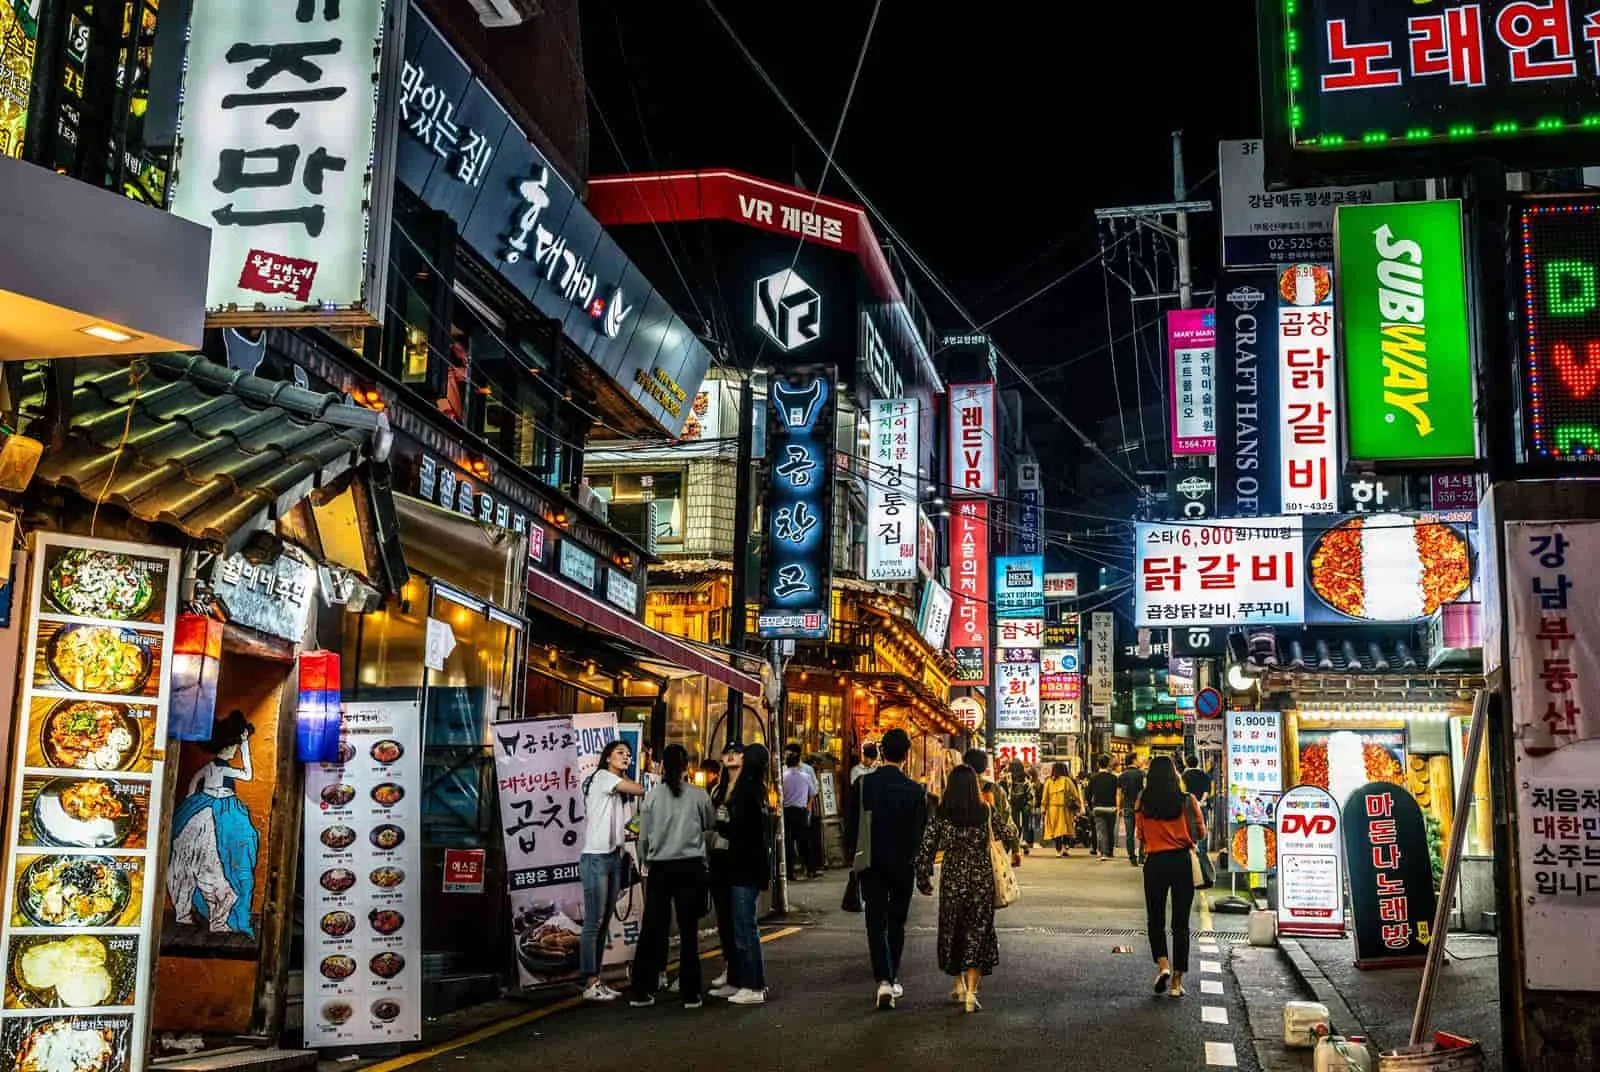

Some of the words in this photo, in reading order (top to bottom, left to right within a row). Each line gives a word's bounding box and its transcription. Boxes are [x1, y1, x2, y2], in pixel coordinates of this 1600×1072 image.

[212, 0, 346, 237] 주막
[400, 61, 460, 158] 맛있는
[458, 129, 492, 187] 집!
[1241, 142, 1258, 155] 3F
[739, 195, 772, 224] VR
[780, 205, 842, 243] 게임존
[1280, 312, 1331, 336] 곱창
[1373, 224, 1434, 437] SUBWAY
[1235, 314, 1258, 396] CRAFT
[1236, 402, 1259, 471] HANS
[1287, 348, 1331, 501] 닭갈비
[774, 445, 817, 597] 곱창고
[878, 464, 908, 546] 정통집
[1143, 552, 1294, 591] 닭갈비
[1528, 532, 1579, 735] 강남부동산
[1000, 665, 1032, 676] 강남
[1009, 677, 1027, 695] 회
[1004, 697, 1032, 708] 수산
[1235, 716, 1276, 726] 6,900원
[523, 732, 575, 753] 곱창고
[498, 773, 560, 794] 대한민국
[506, 796, 585, 854] 곱창
[1281, 814, 1336, 838] DVD
[514, 870, 549, 885] 곱창은
